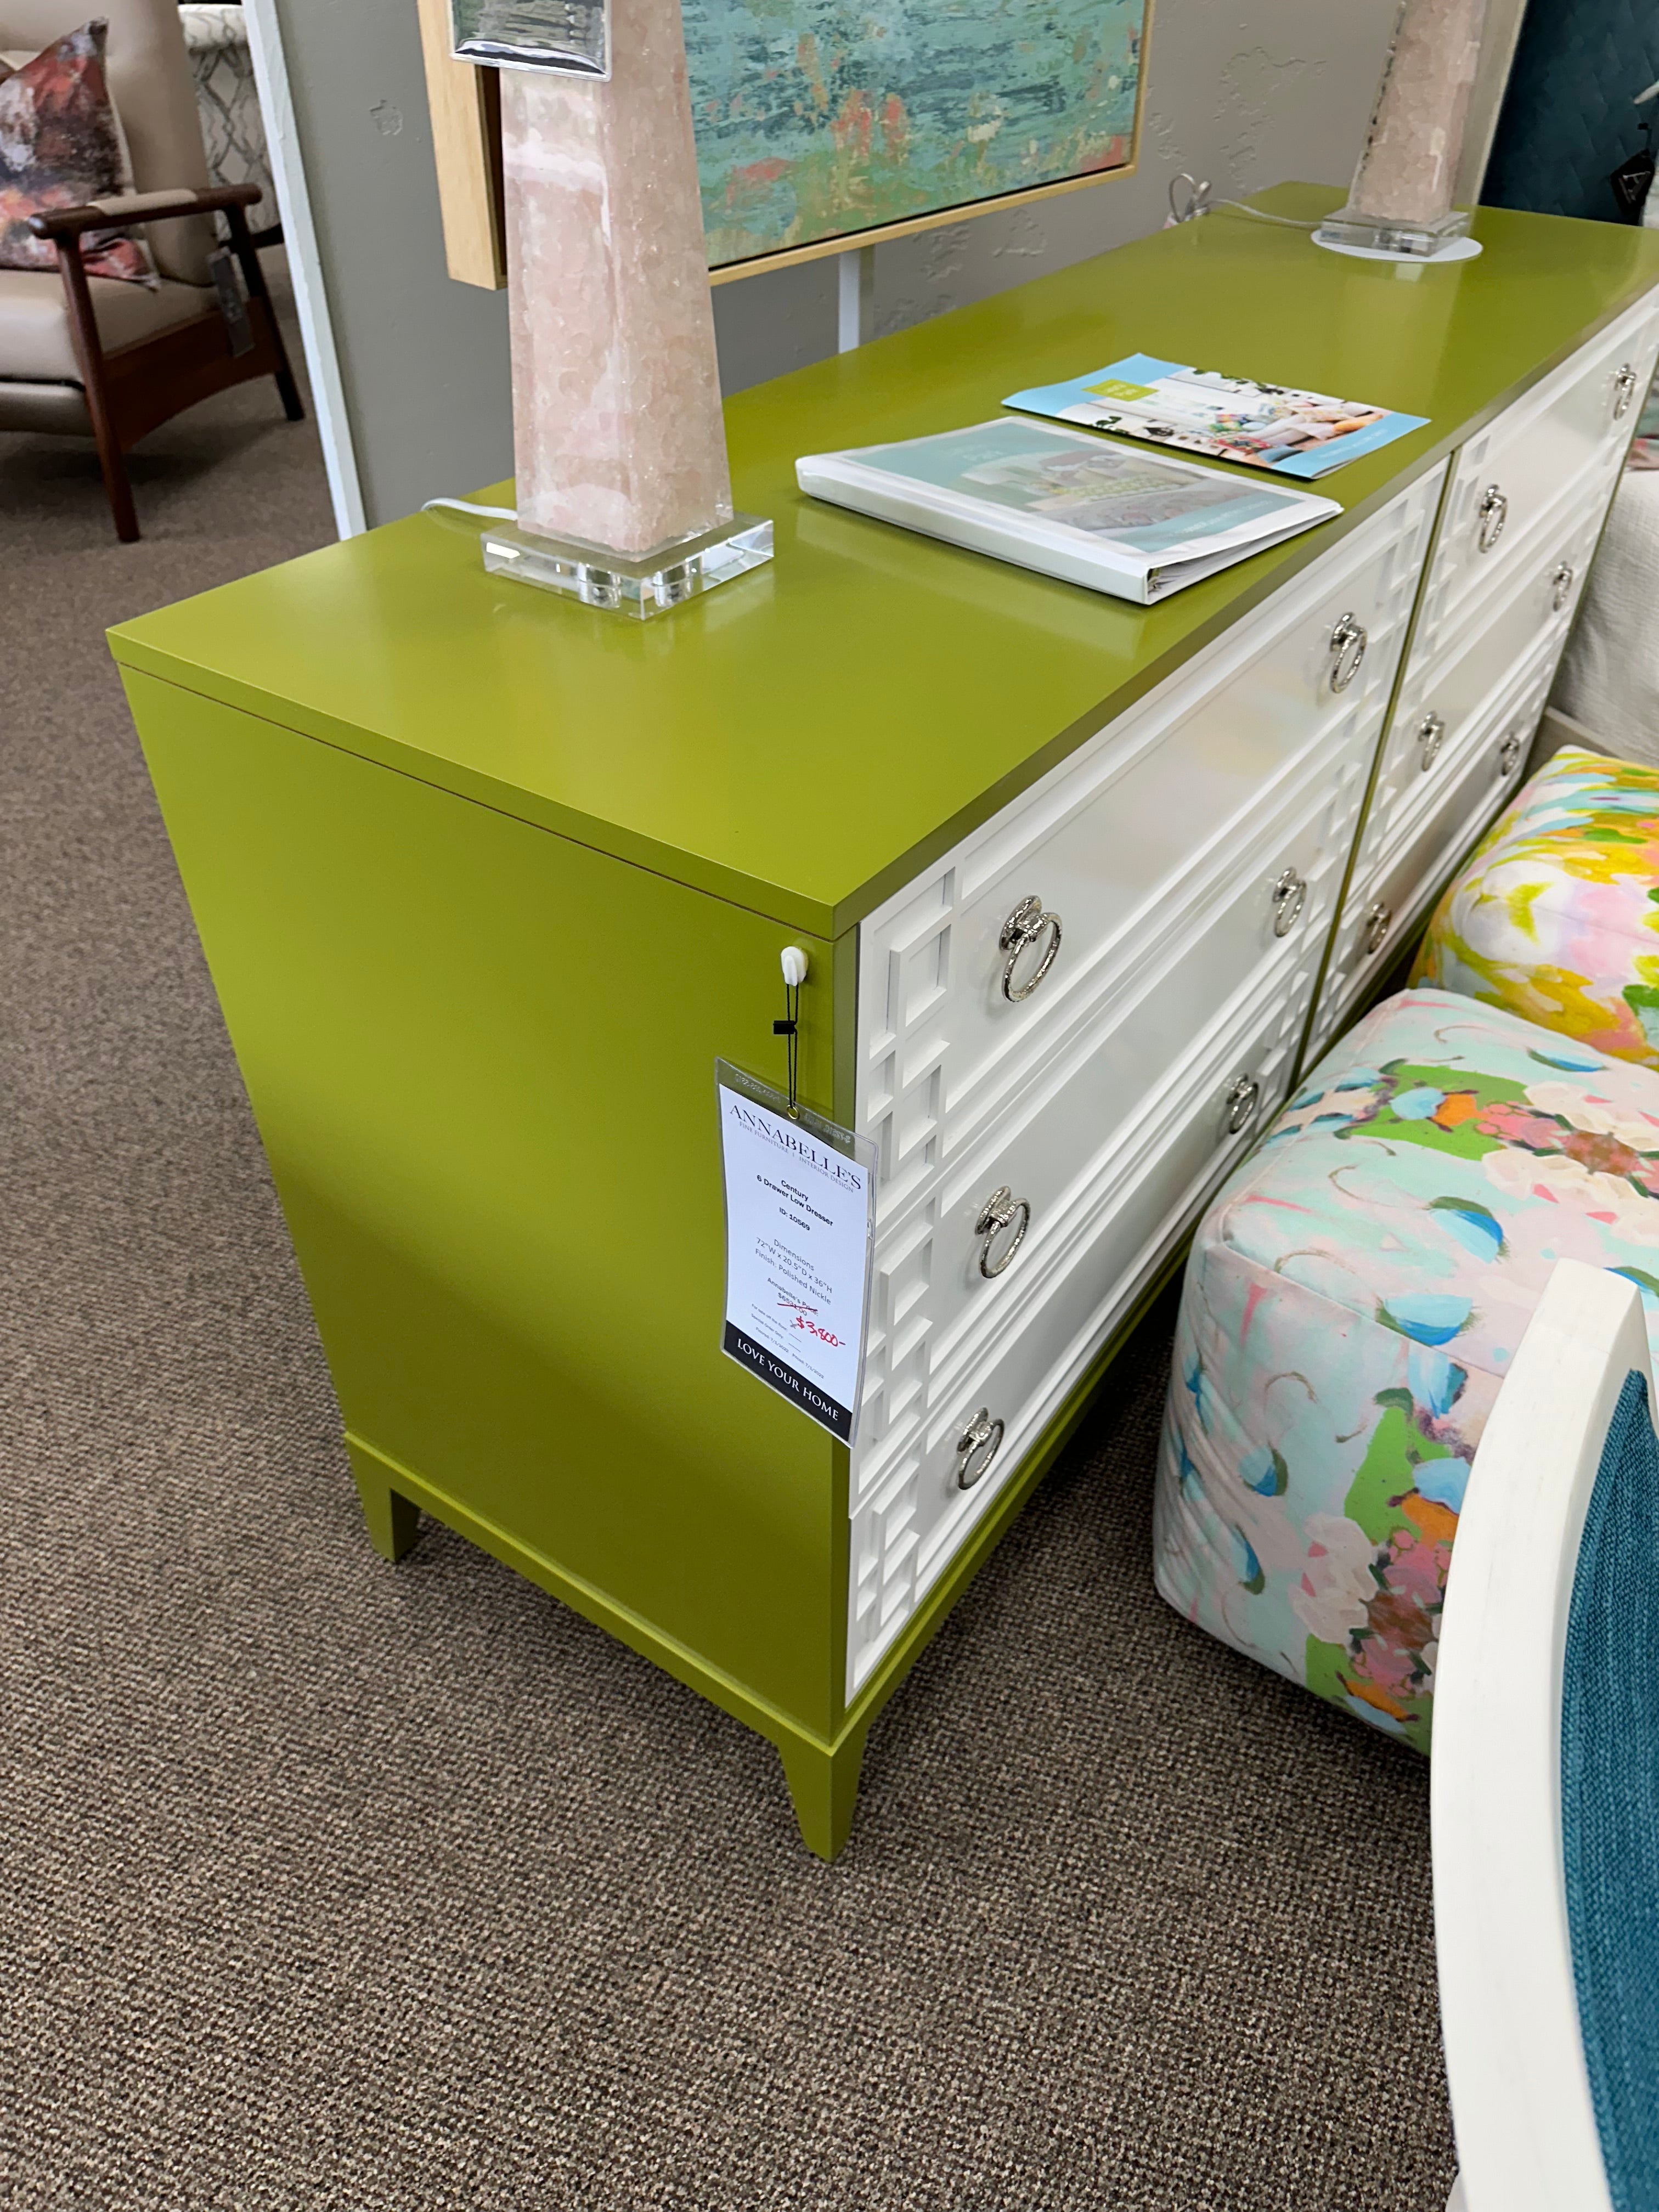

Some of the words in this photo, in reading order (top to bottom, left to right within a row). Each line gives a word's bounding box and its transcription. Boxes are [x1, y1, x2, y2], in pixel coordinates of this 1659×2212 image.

[730, 1105, 861, 1189] ANNABELLE'S
[739, 1121, 753, 1132] FINE
[754, 1130, 788, 1154] FURNITURE
[799, 1155, 830, 1178] INTERIOR
[830, 1175, 854, 1193] DESIGN
[764, 1178, 789, 1198] Drawer
[790, 1194, 804, 1207] Low
[806, 1204, 833, 1226] Dresser
[781, 1180, 809, 1201] Century
[779, 1207, 788, 1217] ID:
[789, 1214, 810, 1231] 10569
[755, 1248, 777, 1267] Finish:
[778, 1264, 808, 1289] Polished
[809, 1285, 831, 1305] Nickle
[774, 1239, 814, 1271] Dimensions
[767, 1277, 801, 1304] Annabelle's
[738, 1338, 765, 1365] LOVE
[768, 1360, 800, 1392] YOUR
[803, 1386, 839, 1421] HOME
